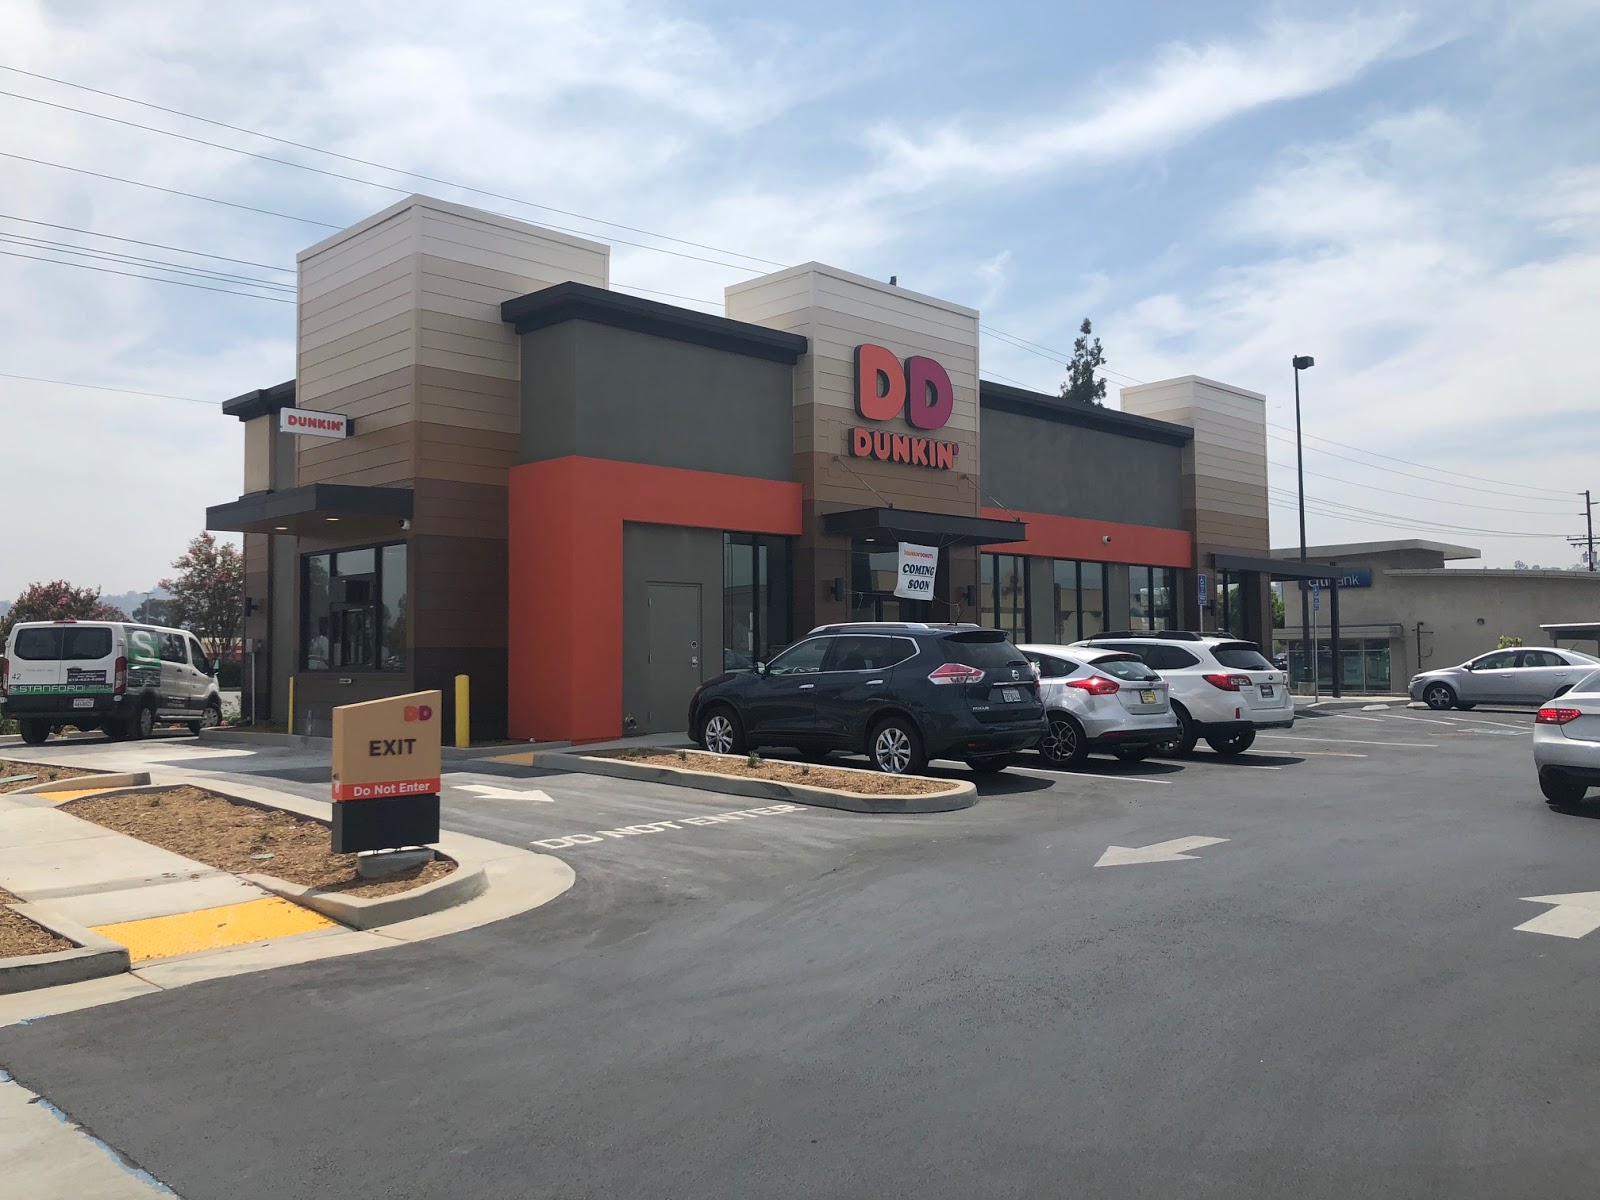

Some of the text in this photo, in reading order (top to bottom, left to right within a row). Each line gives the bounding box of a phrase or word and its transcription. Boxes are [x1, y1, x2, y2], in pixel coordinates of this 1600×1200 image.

[854, 344, 953, 430] DD
[288, 415, 343, 431] DUNKIN'
[849, 426, 959, 470] DUNKIN'
[903, 563, 935, 576] COMING
[908, 579, 930, 590] SOON
[1308, 574, 1360, 587] citiank
[20, 684, 84, 693] STANFORD
[404, 705, 432, 722] DD
[369, 739, 416, 756] EXIT
[353, 782, 430, 797] Do Not Enter
[530, 804, 808, 850] DO NOT ENTER
